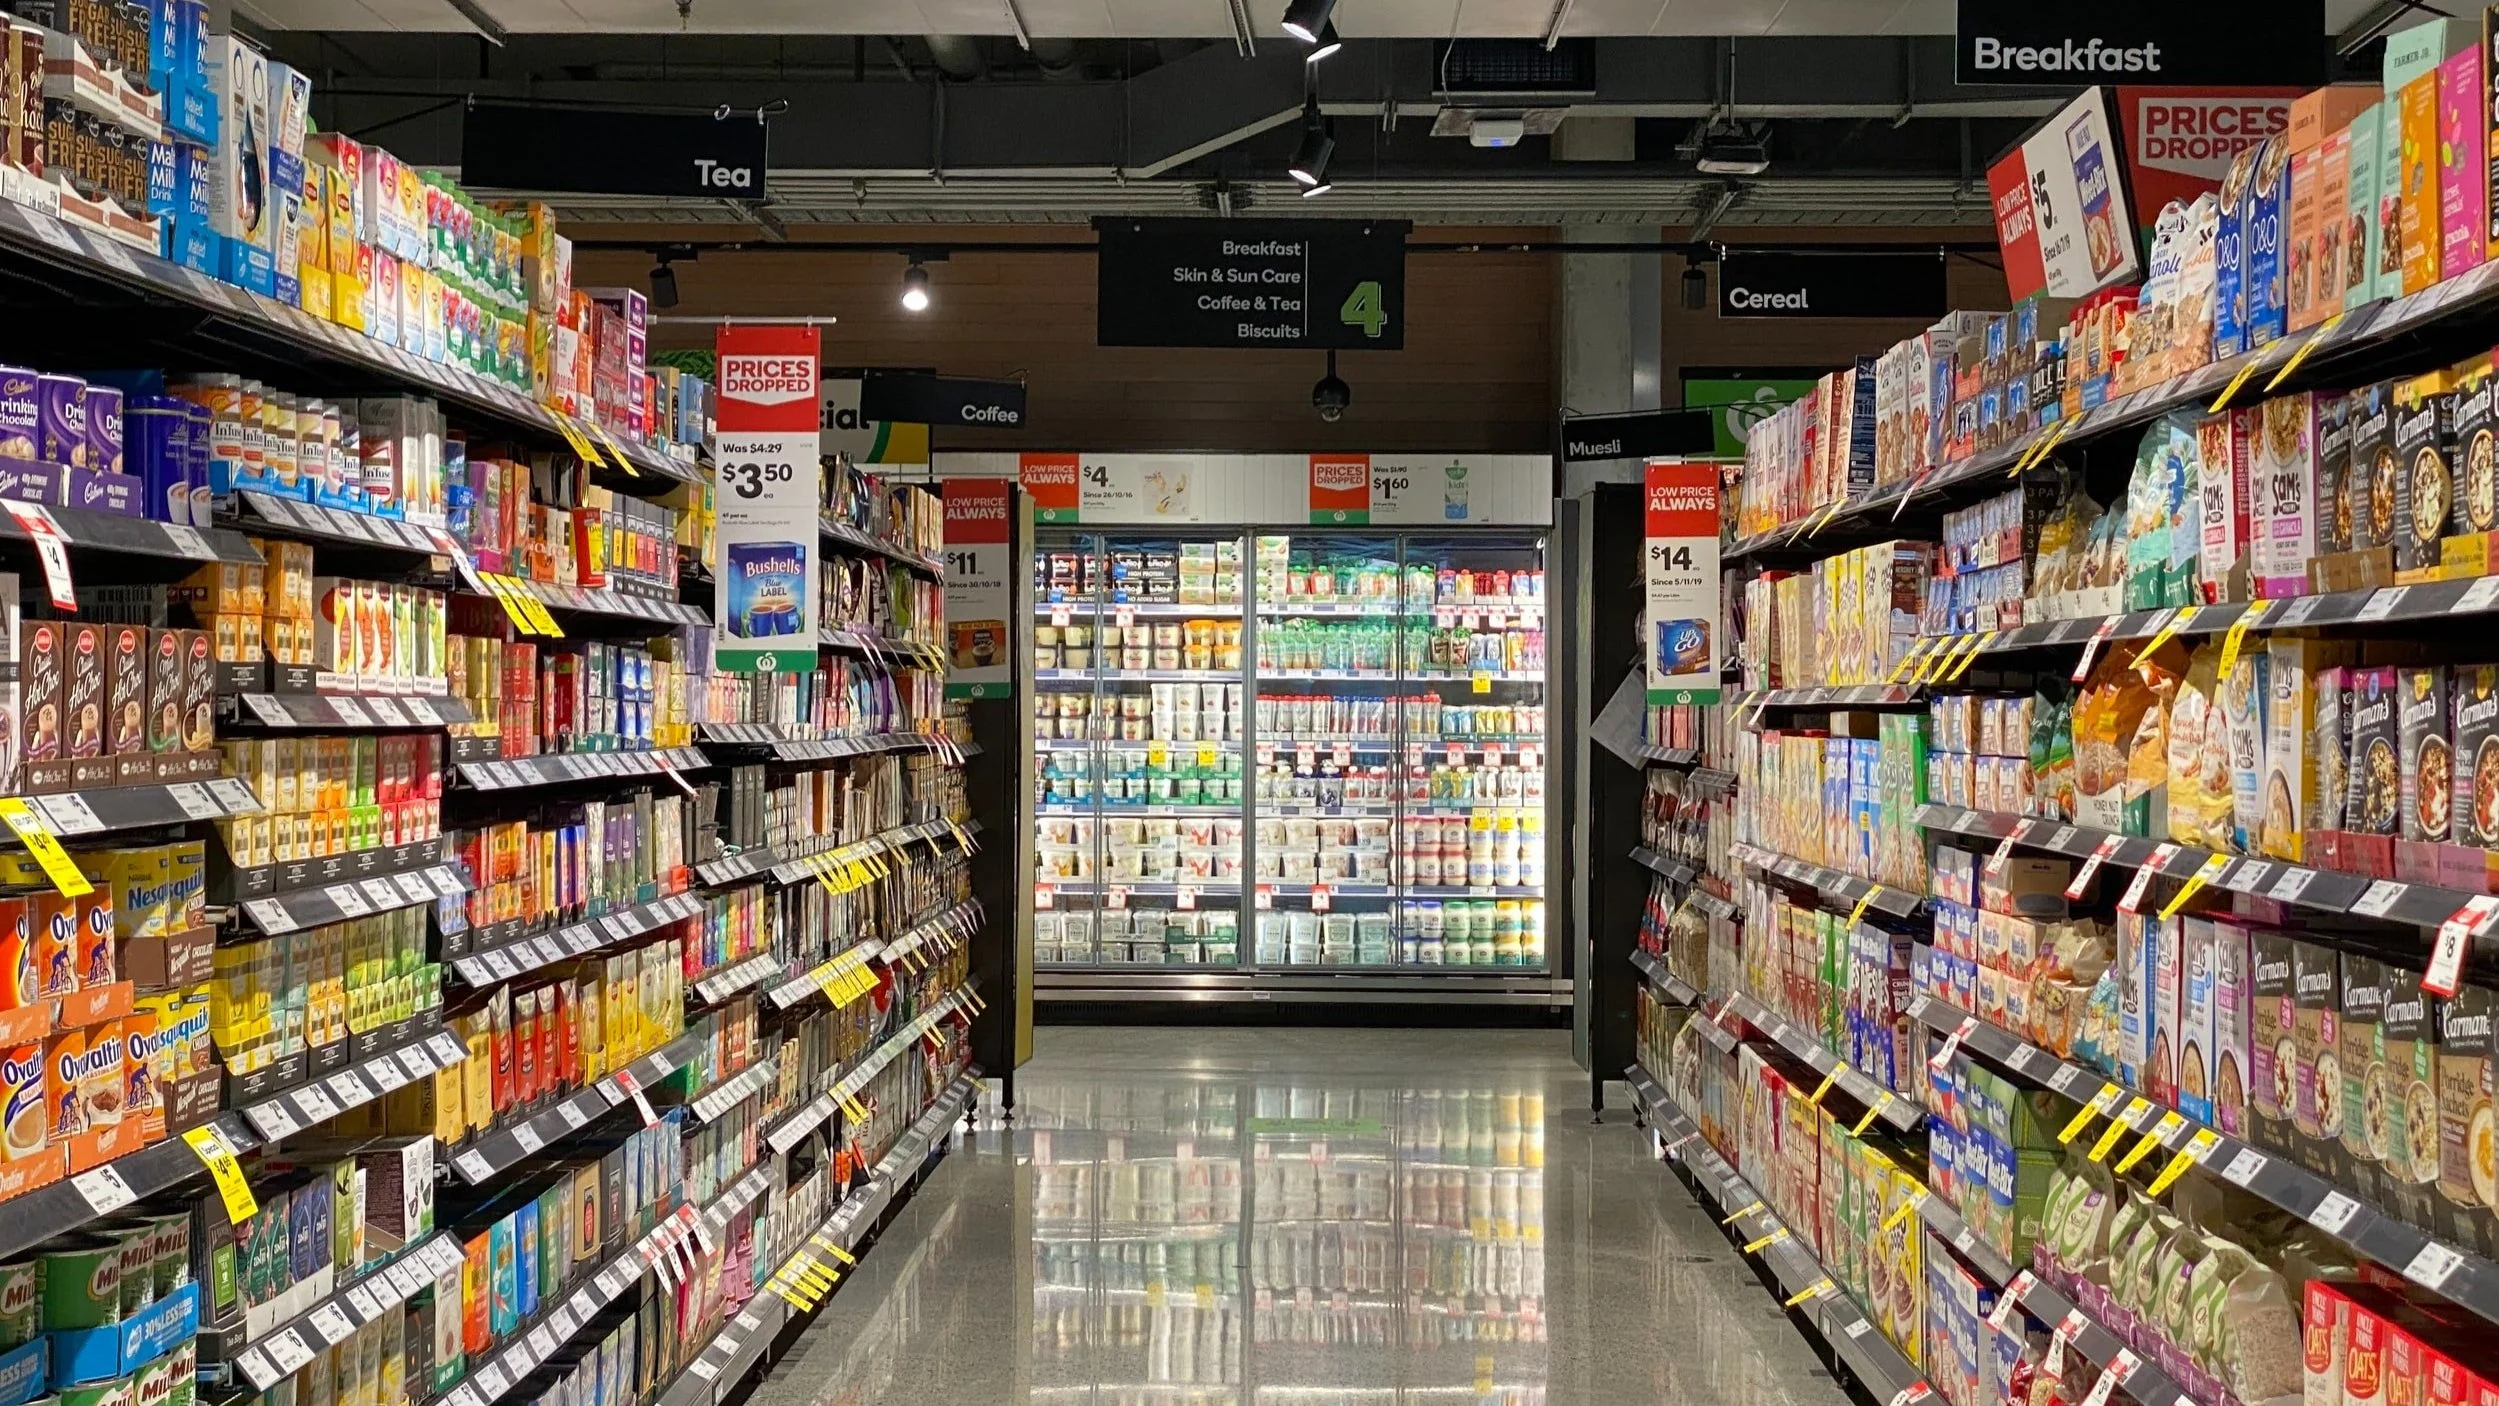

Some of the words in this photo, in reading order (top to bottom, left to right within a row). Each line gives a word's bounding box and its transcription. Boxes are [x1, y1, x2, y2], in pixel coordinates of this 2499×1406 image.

[164, 25, 176, 44] Mi
[1974, 37, 2161, 72] Breakfast
[2146, 106, 2288, 135] PRICES
[2145, 137, 2265, 159] DROPP
[694, 159, 751, 188] Tea
[152, 186, 173, 200] Drink
[2010, 182, 2028, 210] PRICE
[2002, 205, 2033, 246] ALWAYS
[1222, 241, 1302, 256] Breakfast
[1173, 267, 1208, 282] Skin
[1211, 268, 1224, 283] &
[1226, 268, 1258, 283] Sun
[1262, 269, 1301, 284] Care
[1198, 296, 1251, 311] Coffee
[1254, 296, 1266, 311] &
[1270, 296, 1301, 312] Tea
[1729, 286, 1809, 310] Cereal
[1340, 281, 1388, 338] 4
[1238, 324, 1301, 338] Biscuits
[726, 360, 810, 378] PRICES
[726, 379, 810, 392] DROPPED
[0, 398, 38, 418] rinking
[960, 404, 1019, 422] Coffee
[2395, 400, 2434, 448] Carman's
[722, 444, 748, 453] Was
[750, 444, 782, 454] $4.29
[1569, 439, 1621, 456] Muesli
[1024, 466, 1046, 474] LOW
[1047, 465, 1075, 474] PRICE
[1024, 474, 1076, 484] ALWAYS
[1083, 466, 1108, 488] $4
[1316, 466, 1363, 476] PRICES
[1316, 476, 1363, 484] DROPPED
[1650, 487, 1678, 496] LOW
[1680, 486, 1714, 496] PRICE
[946, 498, 970, 507] LOW
[973, 497, 1005, 506] PRICE
[1650, 498, 1716, 510] ALWAYS
[946, 508, 1006, 520] ALWAYS
[746, 557, 800, 578] Bushells
[948, 552, 976, 575] $11
[1651, 546, 1692, 571] $14
[760, 587, 788, 597] LABEL
[1674, 636, 1700, 652] GO
[2456, 694, 2497, 728] Carman's
[2255, 952, 2289, 982] Carman's
[2296, 962, 2331, 994] Carman's
[2383, 989, 2424, 1024] Carman's
[160, 1309, 180, 1331] LESS
[2306, 1324, 2328, 1356] OATS
[2348, 1348, 2377, 1381] OATS
[2388, 1370, 2412, 1404] OATS
